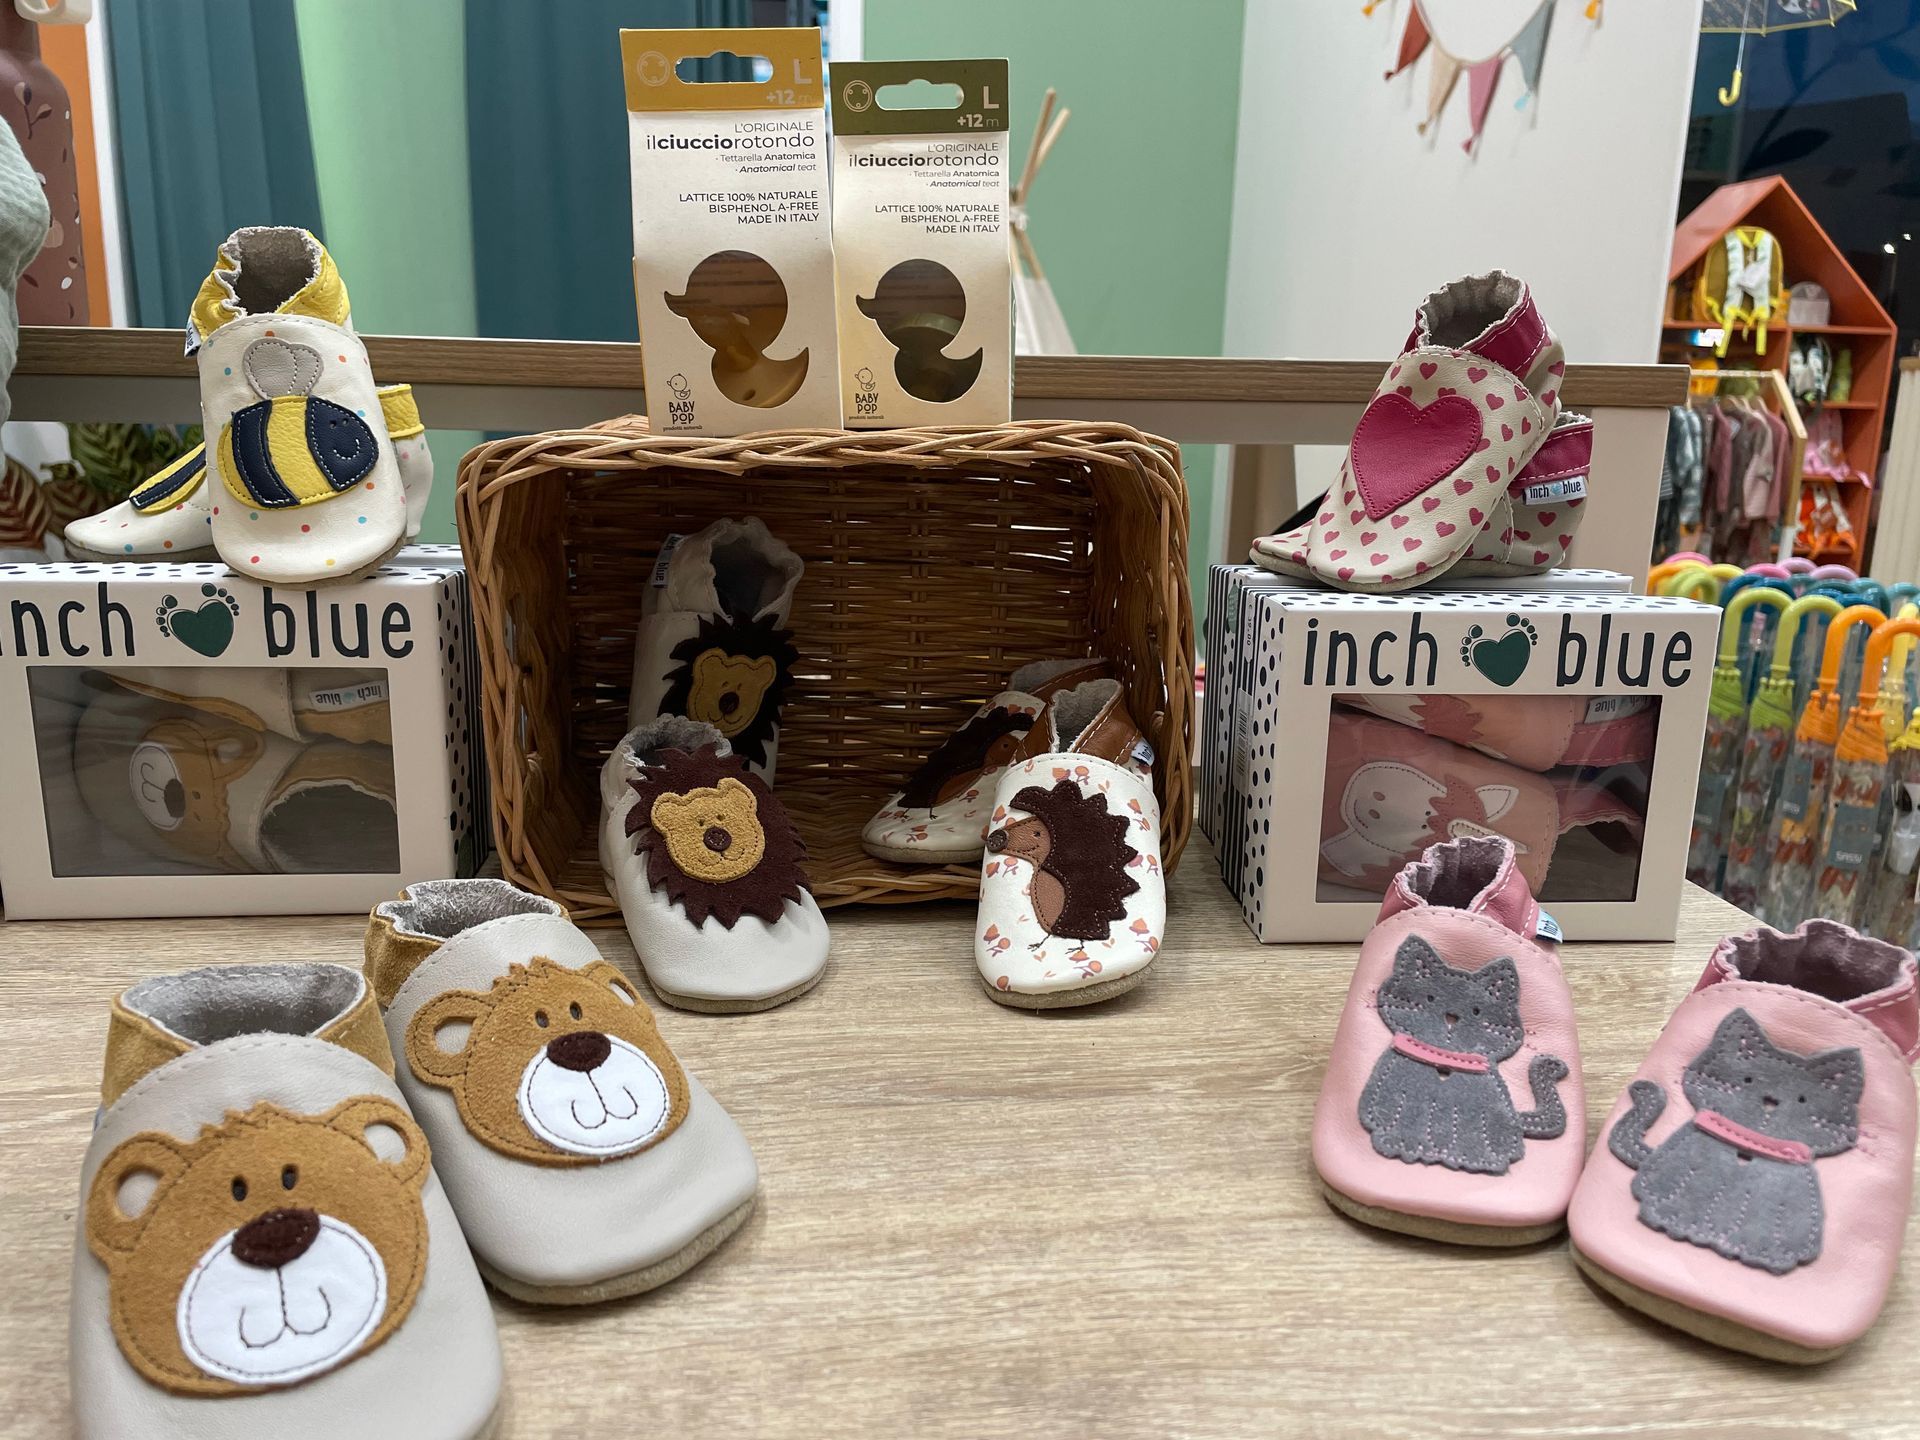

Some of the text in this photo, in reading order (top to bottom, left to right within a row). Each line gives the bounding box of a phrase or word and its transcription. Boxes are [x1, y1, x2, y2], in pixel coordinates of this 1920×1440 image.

[793, 59, 812, 84] L
[766, 89, 795, 104] +12
[983, 86, 1000, 109] L
[957, 113, 999, 127] +12 m
[734, 121, 814, 133] L'ORIGINALE
[647, 133, 815, 150] ilciucciorotondo
[927, 142, 999, 153] L'ORIGINALE
[720, 152, 816, 162] Tettarella Anatomica
[849, 152, 999, 167] ilciucciorotondo
[739, 164, 796, 173] Anatomical
[914, 170, 951, 178] Tettarella
[679, 191, 818, 202] LATTICE 100% NATURALE
[709, 201, 819, 213] BISPHENOL A-FREE
[875, 204, 1000, 213] LATTICE 100% NATURALE
[737, 213, 820, 224] MADE IN ITALY
[901, 214, 1000, 223] BISPHENOL A-FREE
[926, 224, 1000, 233] MADE IN ITALY
[855, 393, 879, 403] BABY
[668, 401, 695, 413] BABY
[857, 404, 878, 414] POP
[672, 413, 695, 424] POP
[1529, 480, 1582, 499] inch blue
[0, 581, 415, 659] nch blue
[1303, 612, 1693, 688] inch blue
[315, 693, 342, 705] blue
